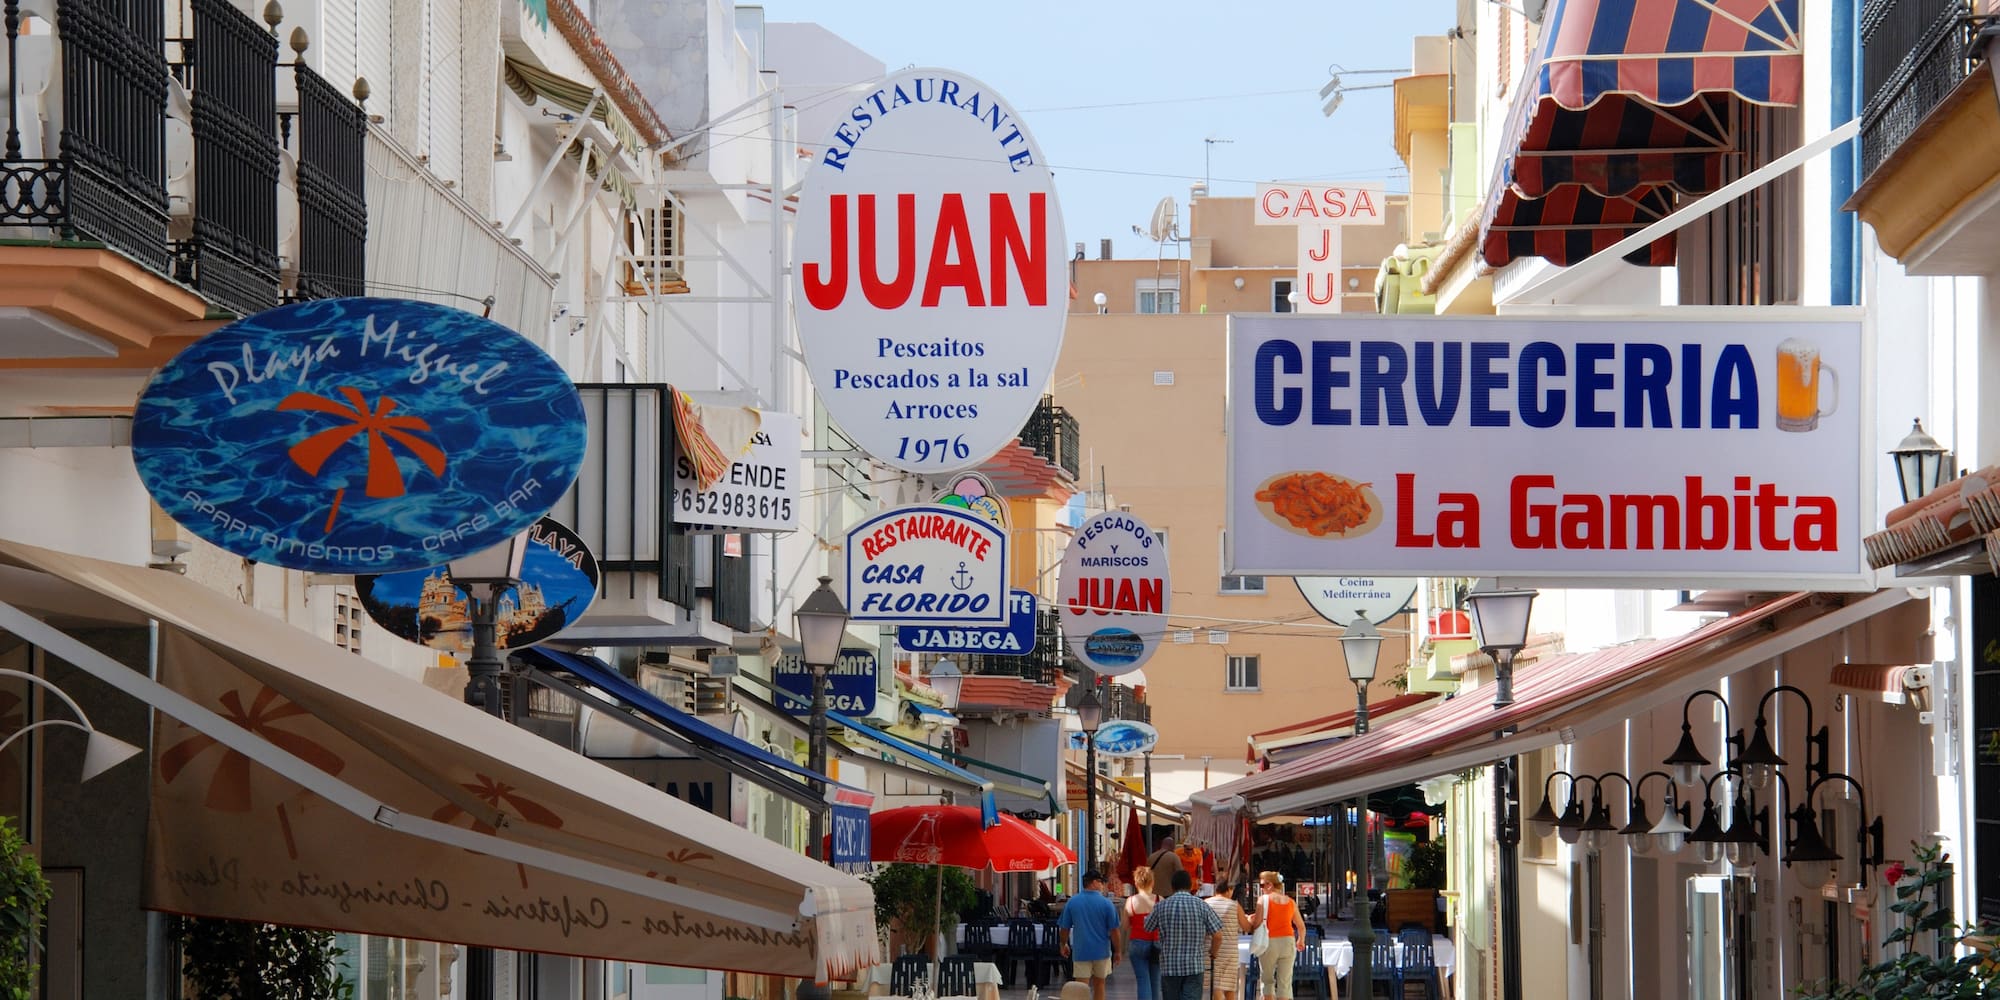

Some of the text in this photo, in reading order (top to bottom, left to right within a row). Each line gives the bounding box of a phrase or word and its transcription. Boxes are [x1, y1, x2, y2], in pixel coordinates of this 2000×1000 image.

[823, 78, 1034, 173] RESTAURANTE
[1262, 188, 1377, 218] CASA
[802, 192, 1047, 311] JUAN
[208, 313, 509, 405] Playa Miguel
[877, 337, 984, 357] Pescaitos
[834, 367, 1029, 389] Pescados a la sal
[1254, 339, 1760, 429] CERVECERIA
[885, 400, 978, 419] Arroces
[896, 434, 970, 463] 1976
[720, 462, 786, 490] ENDE
[682, 488, 791, 521] 652983615
[1395, 473, 1839, 552] La Gambita
[184, 478, 542, 561] APARTAMENTOS CAFÉ BAR
[1077, 517, 1152, 549] PESCADOS
[861, 515, 991, 562] RESTAURANTE
[1110, 545, 1118, 554] Y
[862, 564, 924, 584] CASA
[1081, 556, 1148, 567] MARISCOS
[1323, 590, 1391, 599] Mediterránea
[1339, 577, 1374, 586] Cocina
[861, 593, 990, 613] FLORIDO
[1068, 578, 1163, 616] JUAN
[912, 629, 1021, 650] JABEGA
